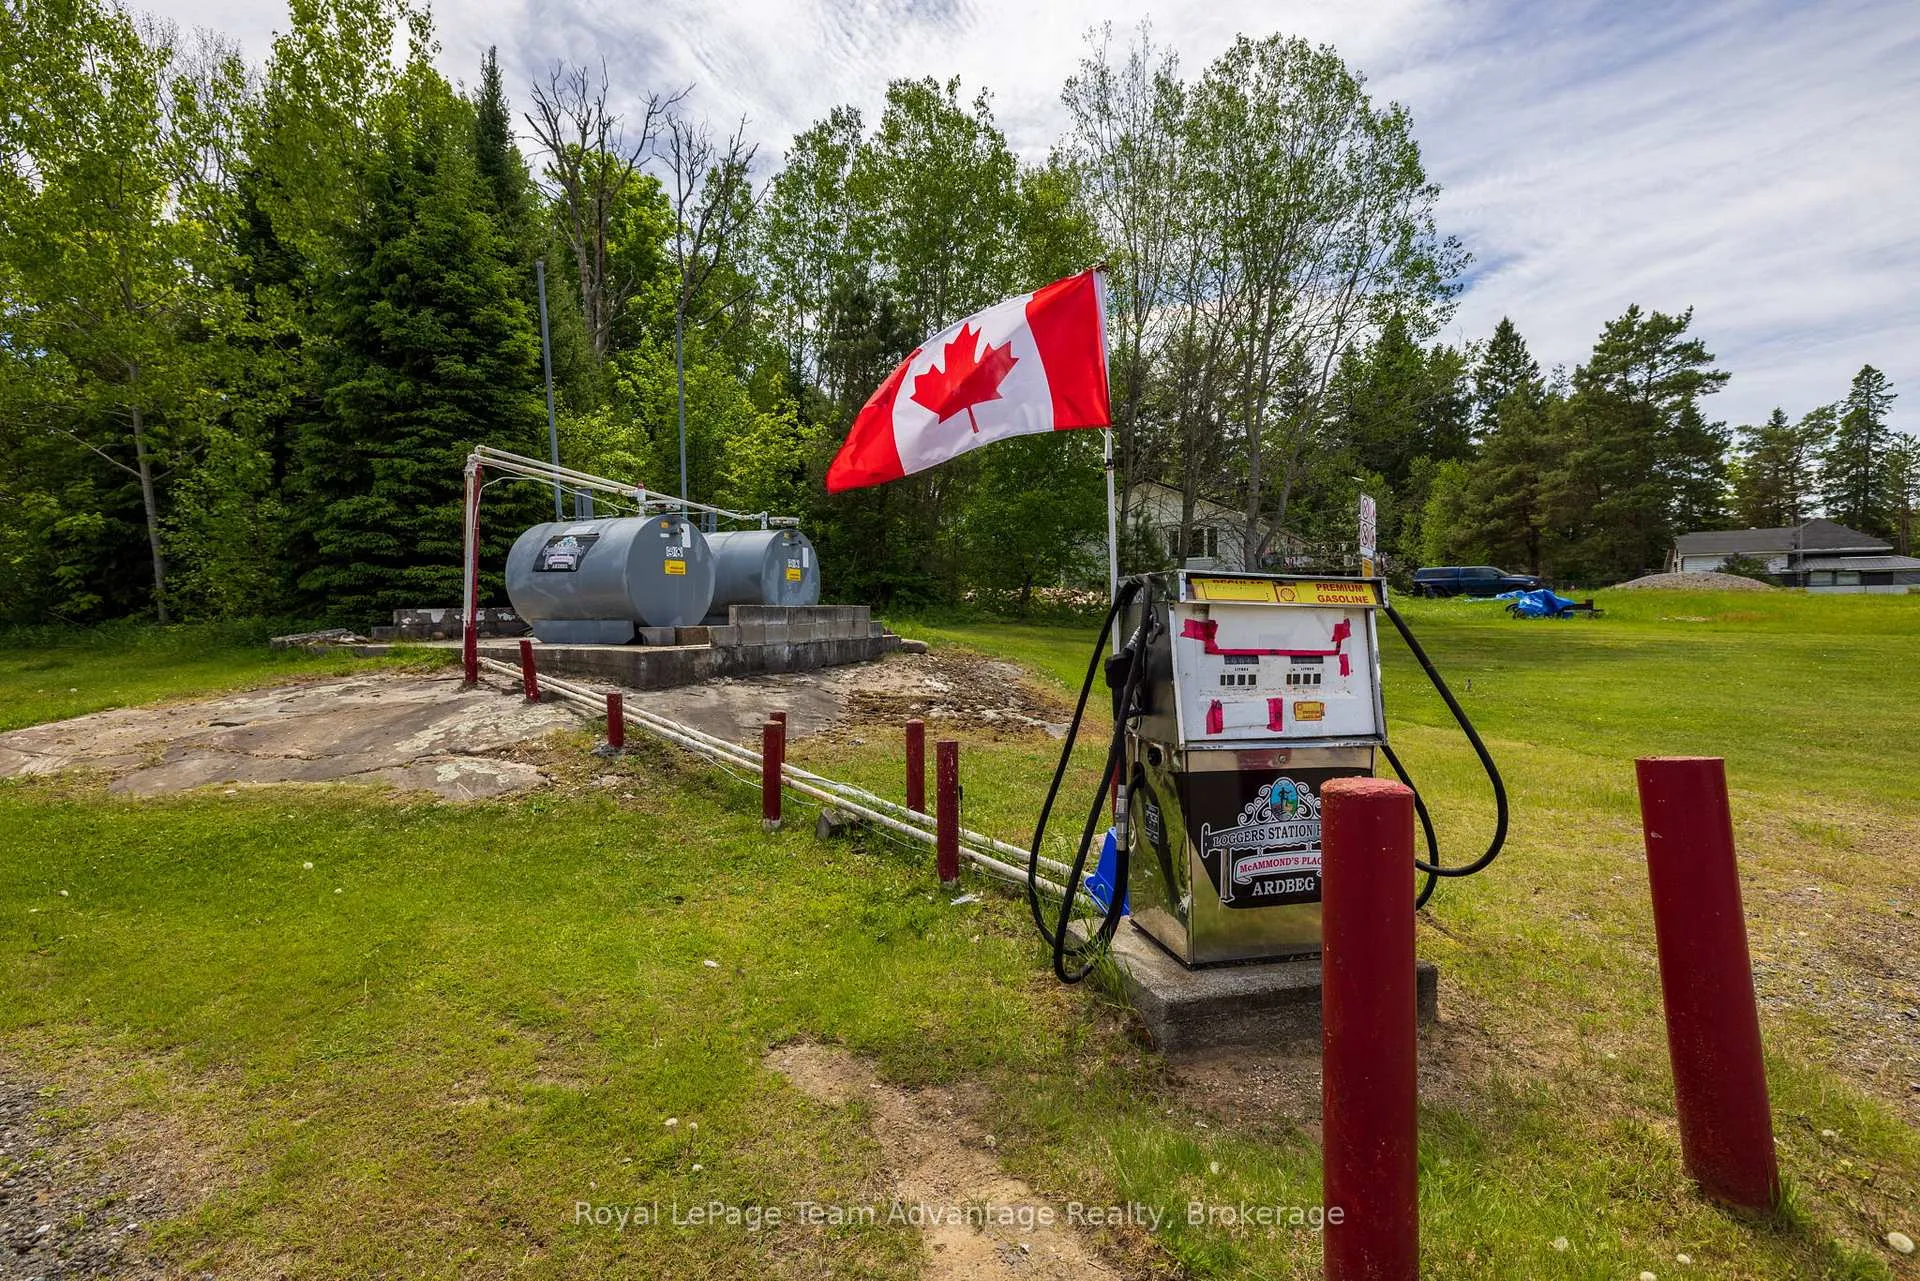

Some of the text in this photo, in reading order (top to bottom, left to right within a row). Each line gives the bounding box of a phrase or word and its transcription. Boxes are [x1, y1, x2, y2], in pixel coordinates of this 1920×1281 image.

[1315, 583, 1364, 592] PREMIUM
[1317, 594, 1369, 604] GASOLINE
[1213, 829, 1265, 846] LOGGERS
[1268, 825, 1313, 839] STATION
[1240, 857, 1299, 872] McAMMOND'S
[1252, 877, 1315, 896] ARDBEG
